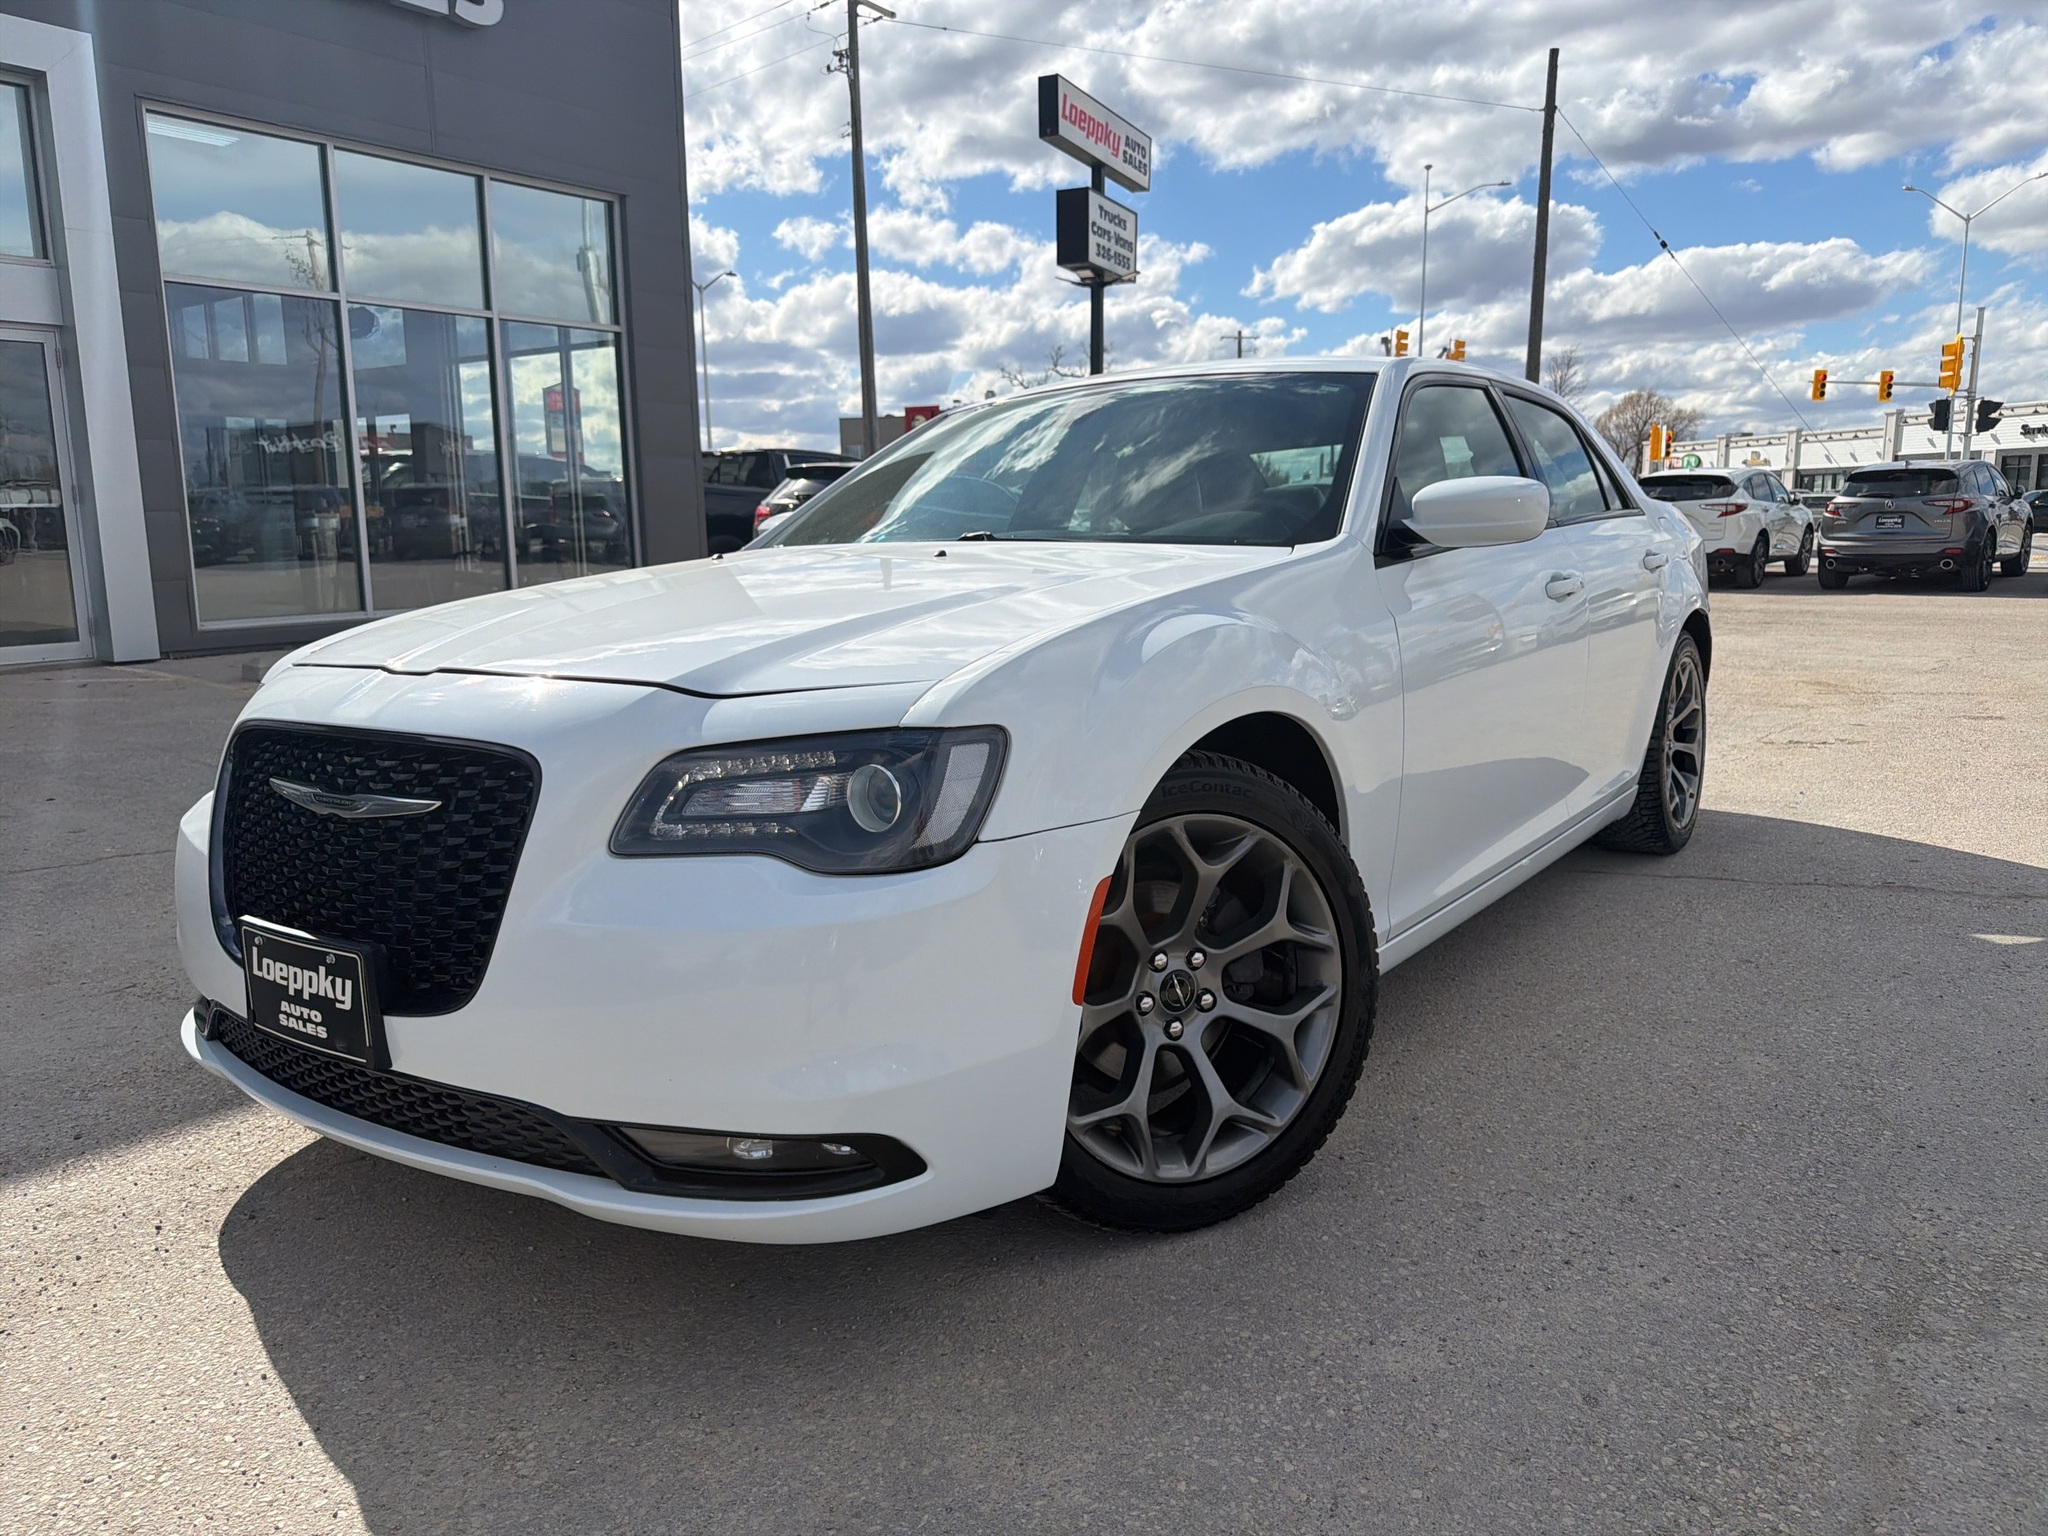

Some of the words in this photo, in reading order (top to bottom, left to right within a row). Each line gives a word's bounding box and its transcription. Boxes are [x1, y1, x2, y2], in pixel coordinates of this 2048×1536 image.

[1061, 93, 1121, 158] Loeppky
[1125, 134, 1146, 159] AUTO
[1123, 150, 1147, 176] SALES
[1098, 204, 1127, 231] Trucks
[1095, 242, 1131, 270] 326-1555
[1161, 780, 1256, 798] IceContac
[252, 946, 352, 1010] Loeppky
[280, 1000, 322, 1022] AUTO
[278, 1013, 328, 1039] SALES
